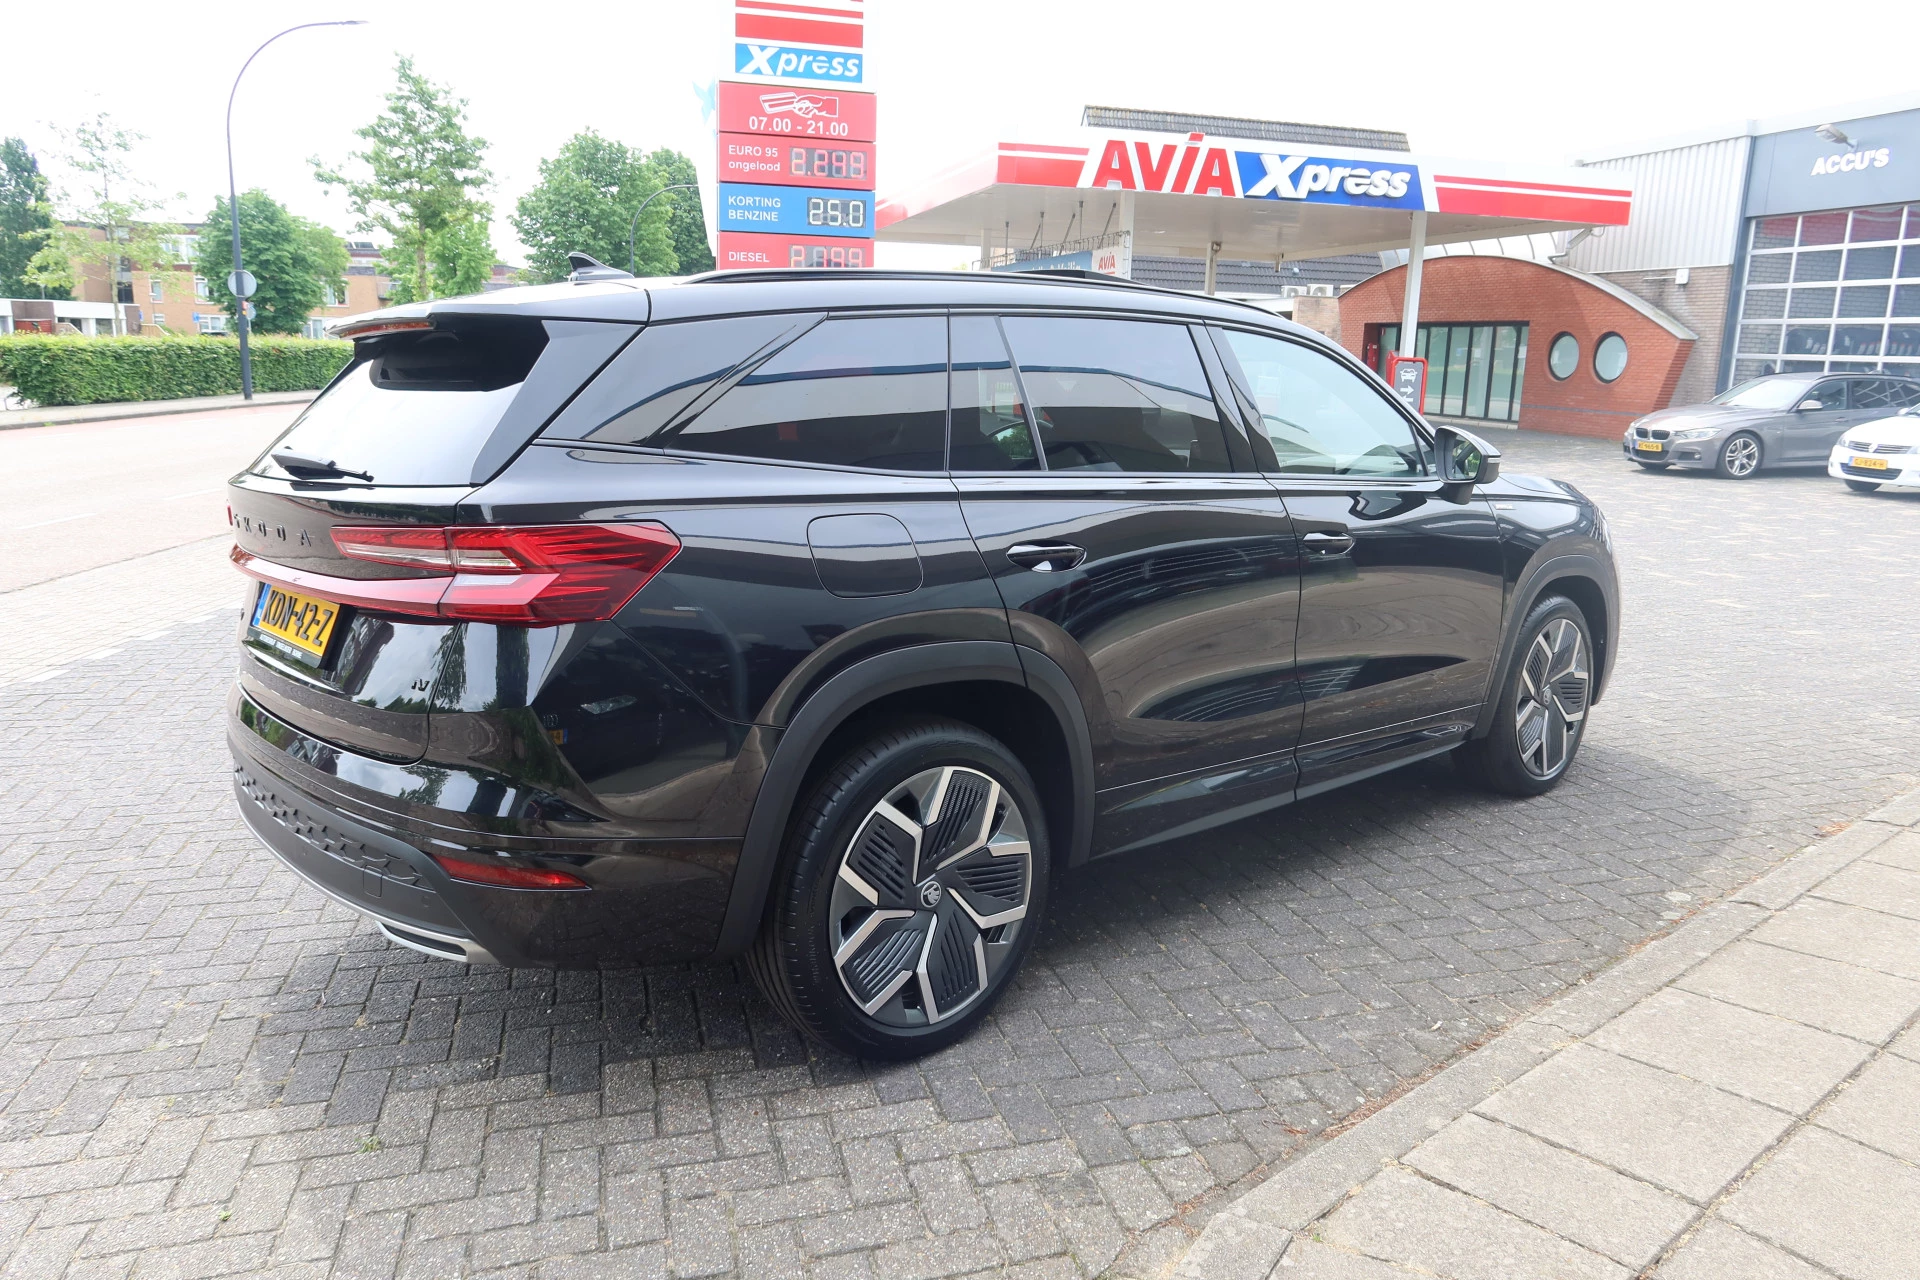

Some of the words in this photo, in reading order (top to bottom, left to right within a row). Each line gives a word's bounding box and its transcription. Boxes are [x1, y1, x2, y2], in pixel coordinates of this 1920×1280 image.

[739, 45, 859, 78] Xpress
[748, 116, 792, 133] 07.00
[806, 120, 849, 137] 21.00
[728, 145, 762, 157] EURO
[764, 147, 778, 158] 95
[791, 148, 865, 179] 2.249
[1810, 147, 1889, 176] ACCU'S
[728, 160, 780, 172] ongelood
[1091, 132, 1236, 198] AVIA
[1244, 153, 1412, 199] Xpress
[728, 195, 781, 208] KORTING
[809, 198, 864, 227] 25.0
[728, 209, 778, 222] BENZINE
[728, 251, 770, 263] DIESEL
[262, 590, 333, 647] KDN-42-Z
